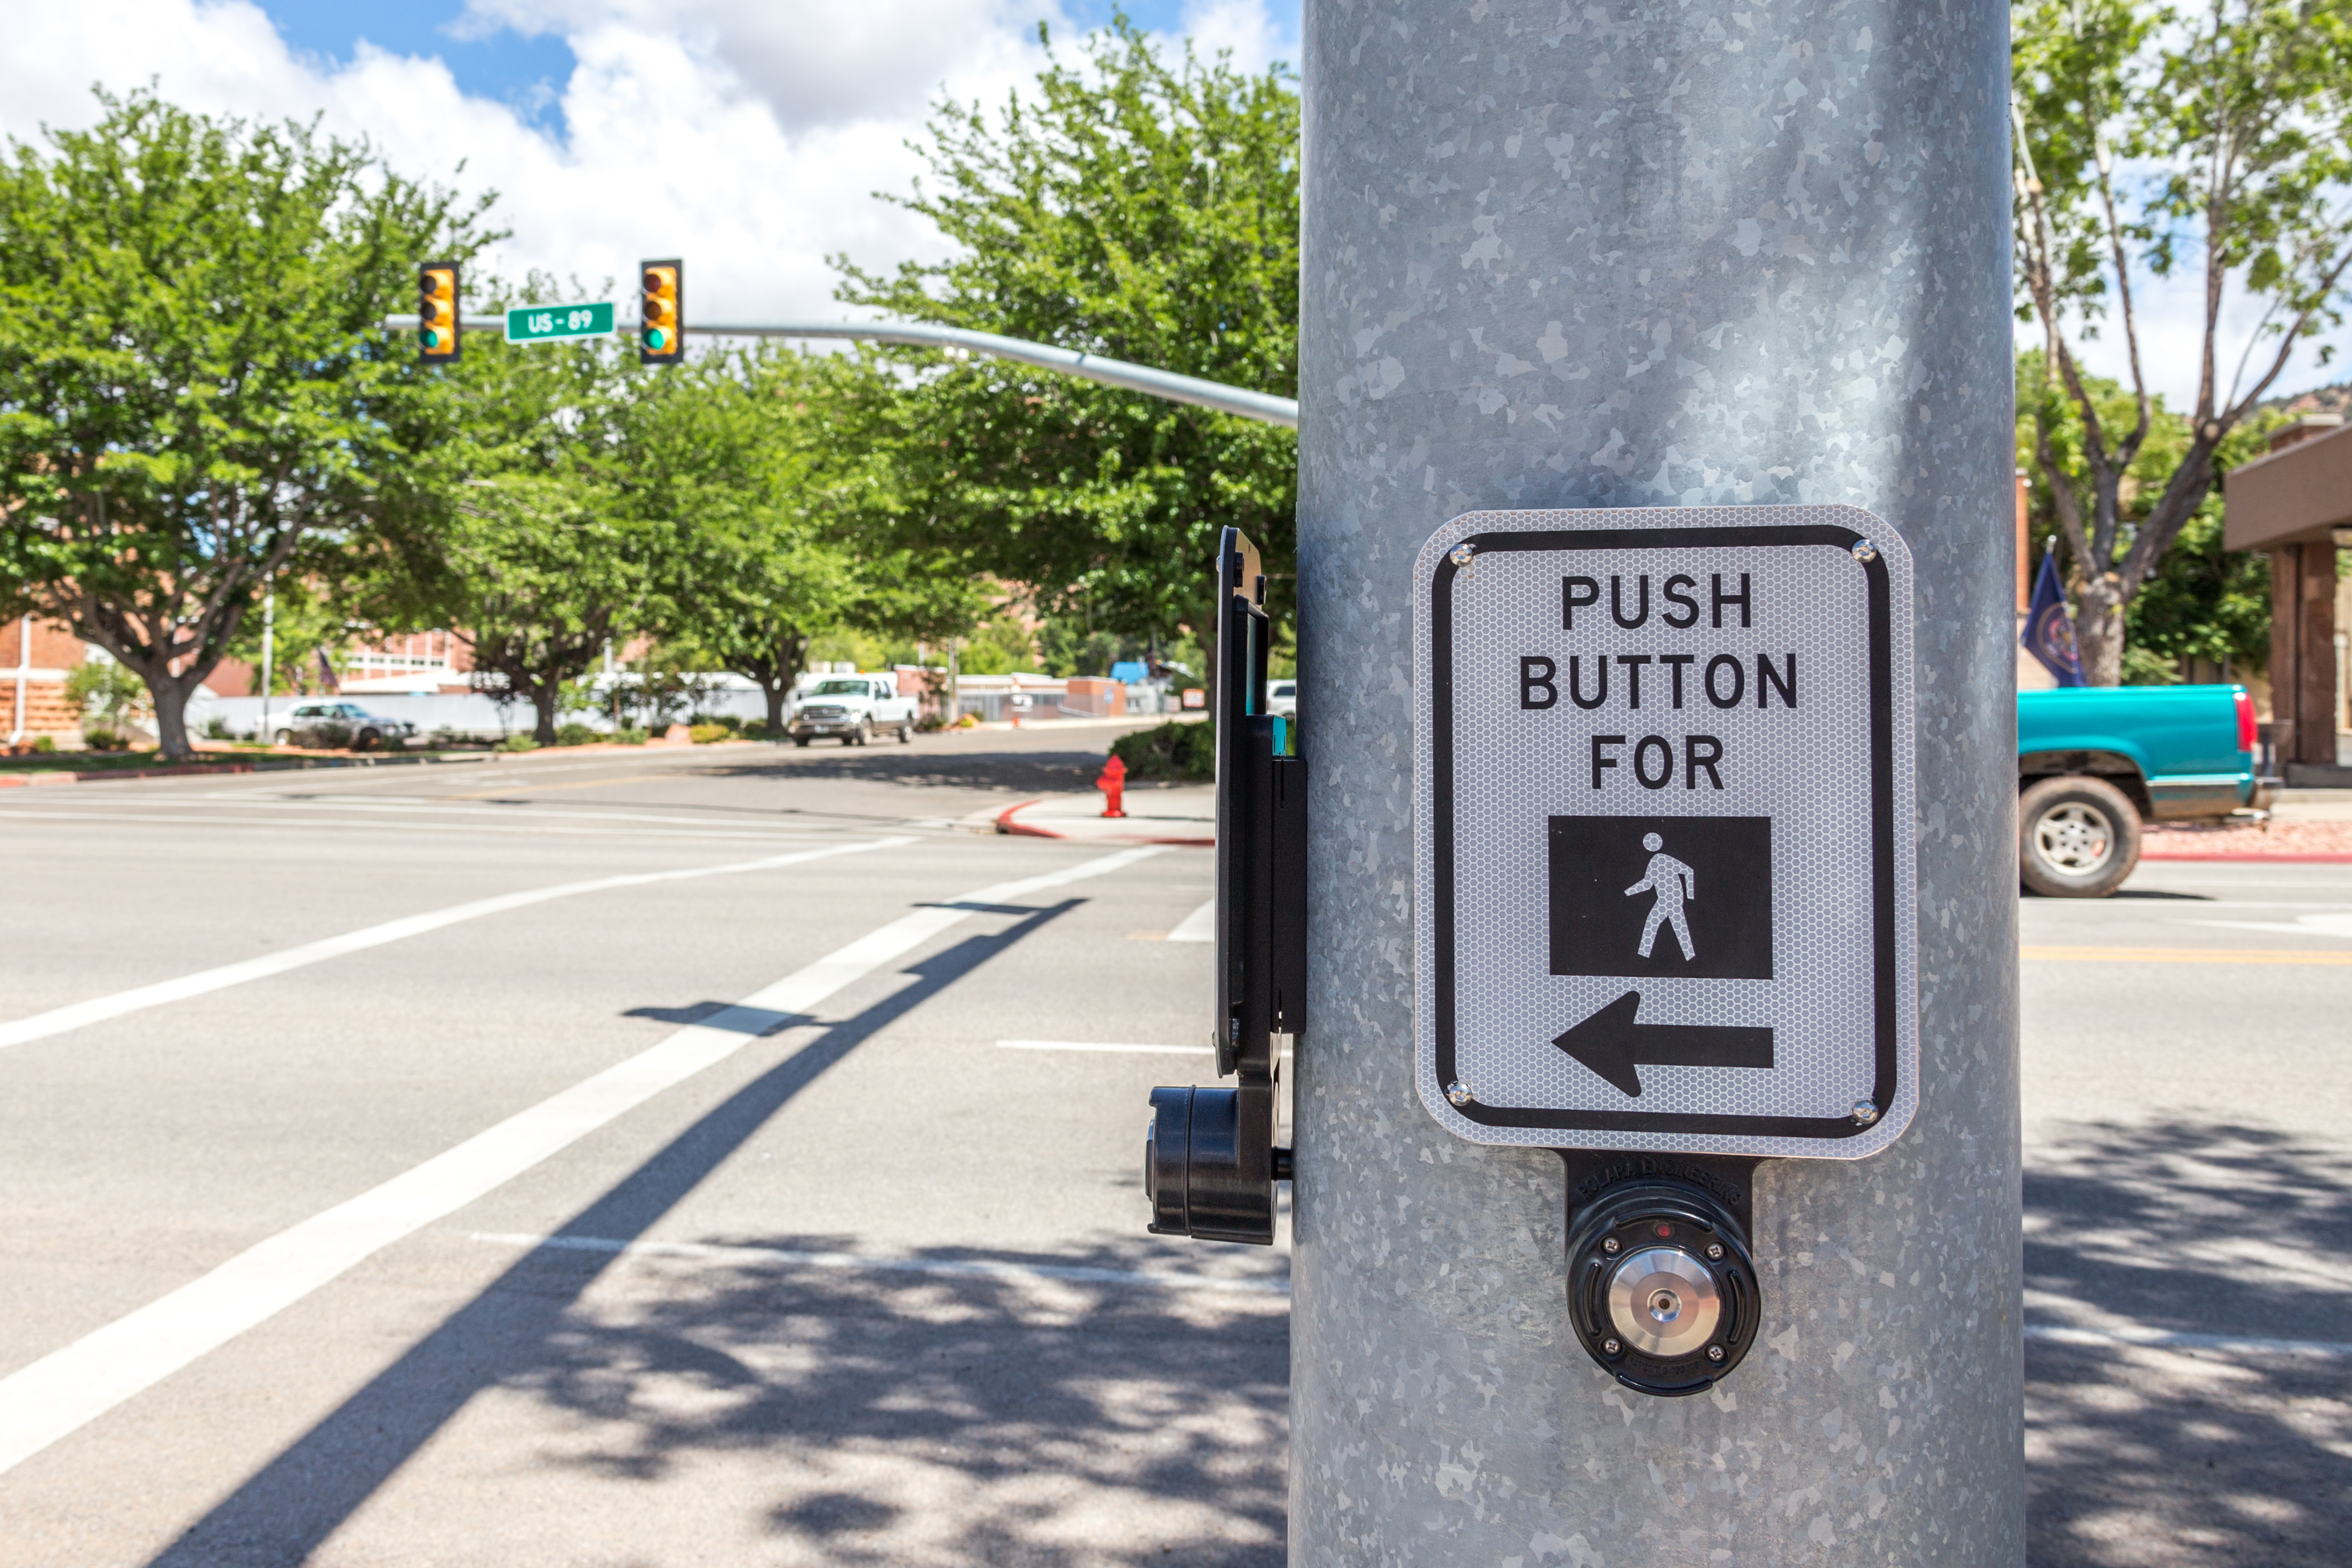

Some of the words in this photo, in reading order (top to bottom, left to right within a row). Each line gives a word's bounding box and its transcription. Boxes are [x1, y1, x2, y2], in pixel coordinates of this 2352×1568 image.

[528, 309, 593, 333] US-89
[1561, 573, 1751, 631] PUSH
[1520, 653, 1797, 710] BUTTON
[1591, 735, 1725, 790] FOR
[1641, 1158, 1742, 1206] ENGINEERING
